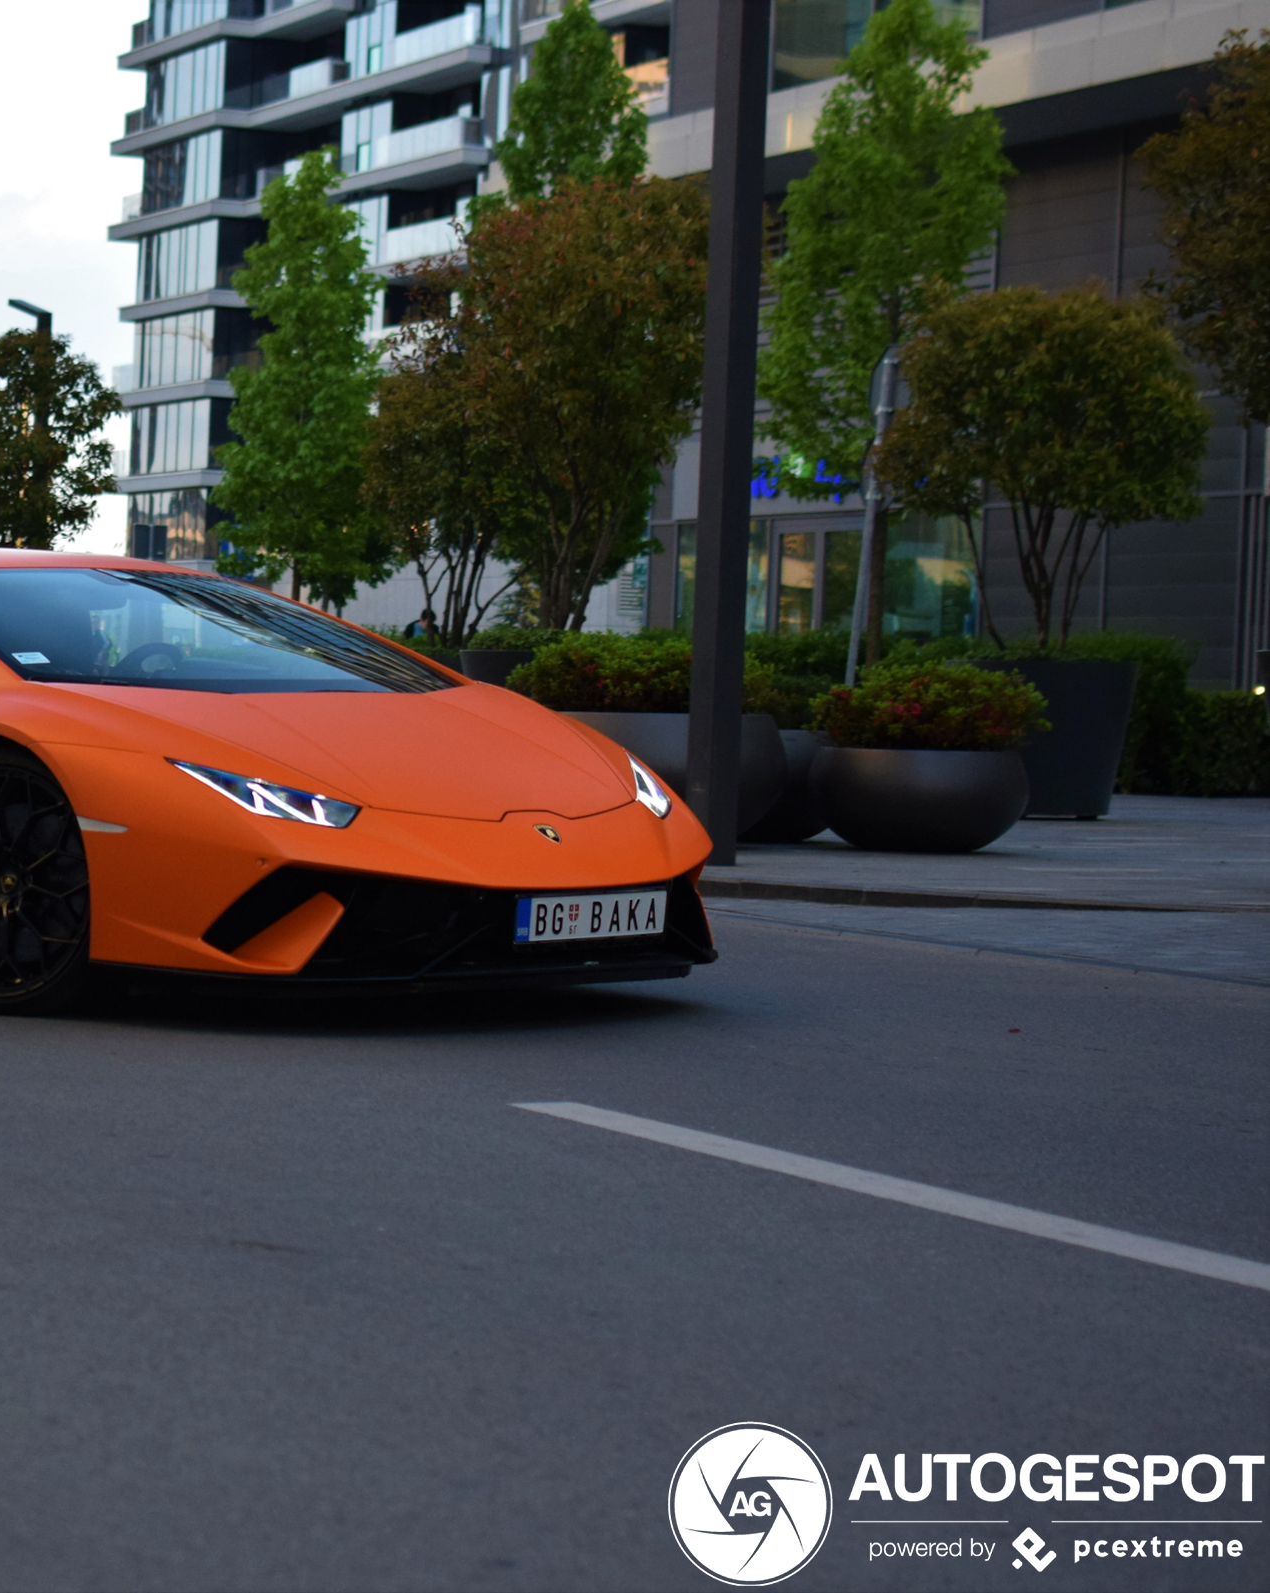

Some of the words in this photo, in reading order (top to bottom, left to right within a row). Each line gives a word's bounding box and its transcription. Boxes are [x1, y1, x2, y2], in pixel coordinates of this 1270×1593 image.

[535, 902, 565, 937] BG
[590, 897, 657, 934] BAKA
[516, 927, 529, 937] SRB
